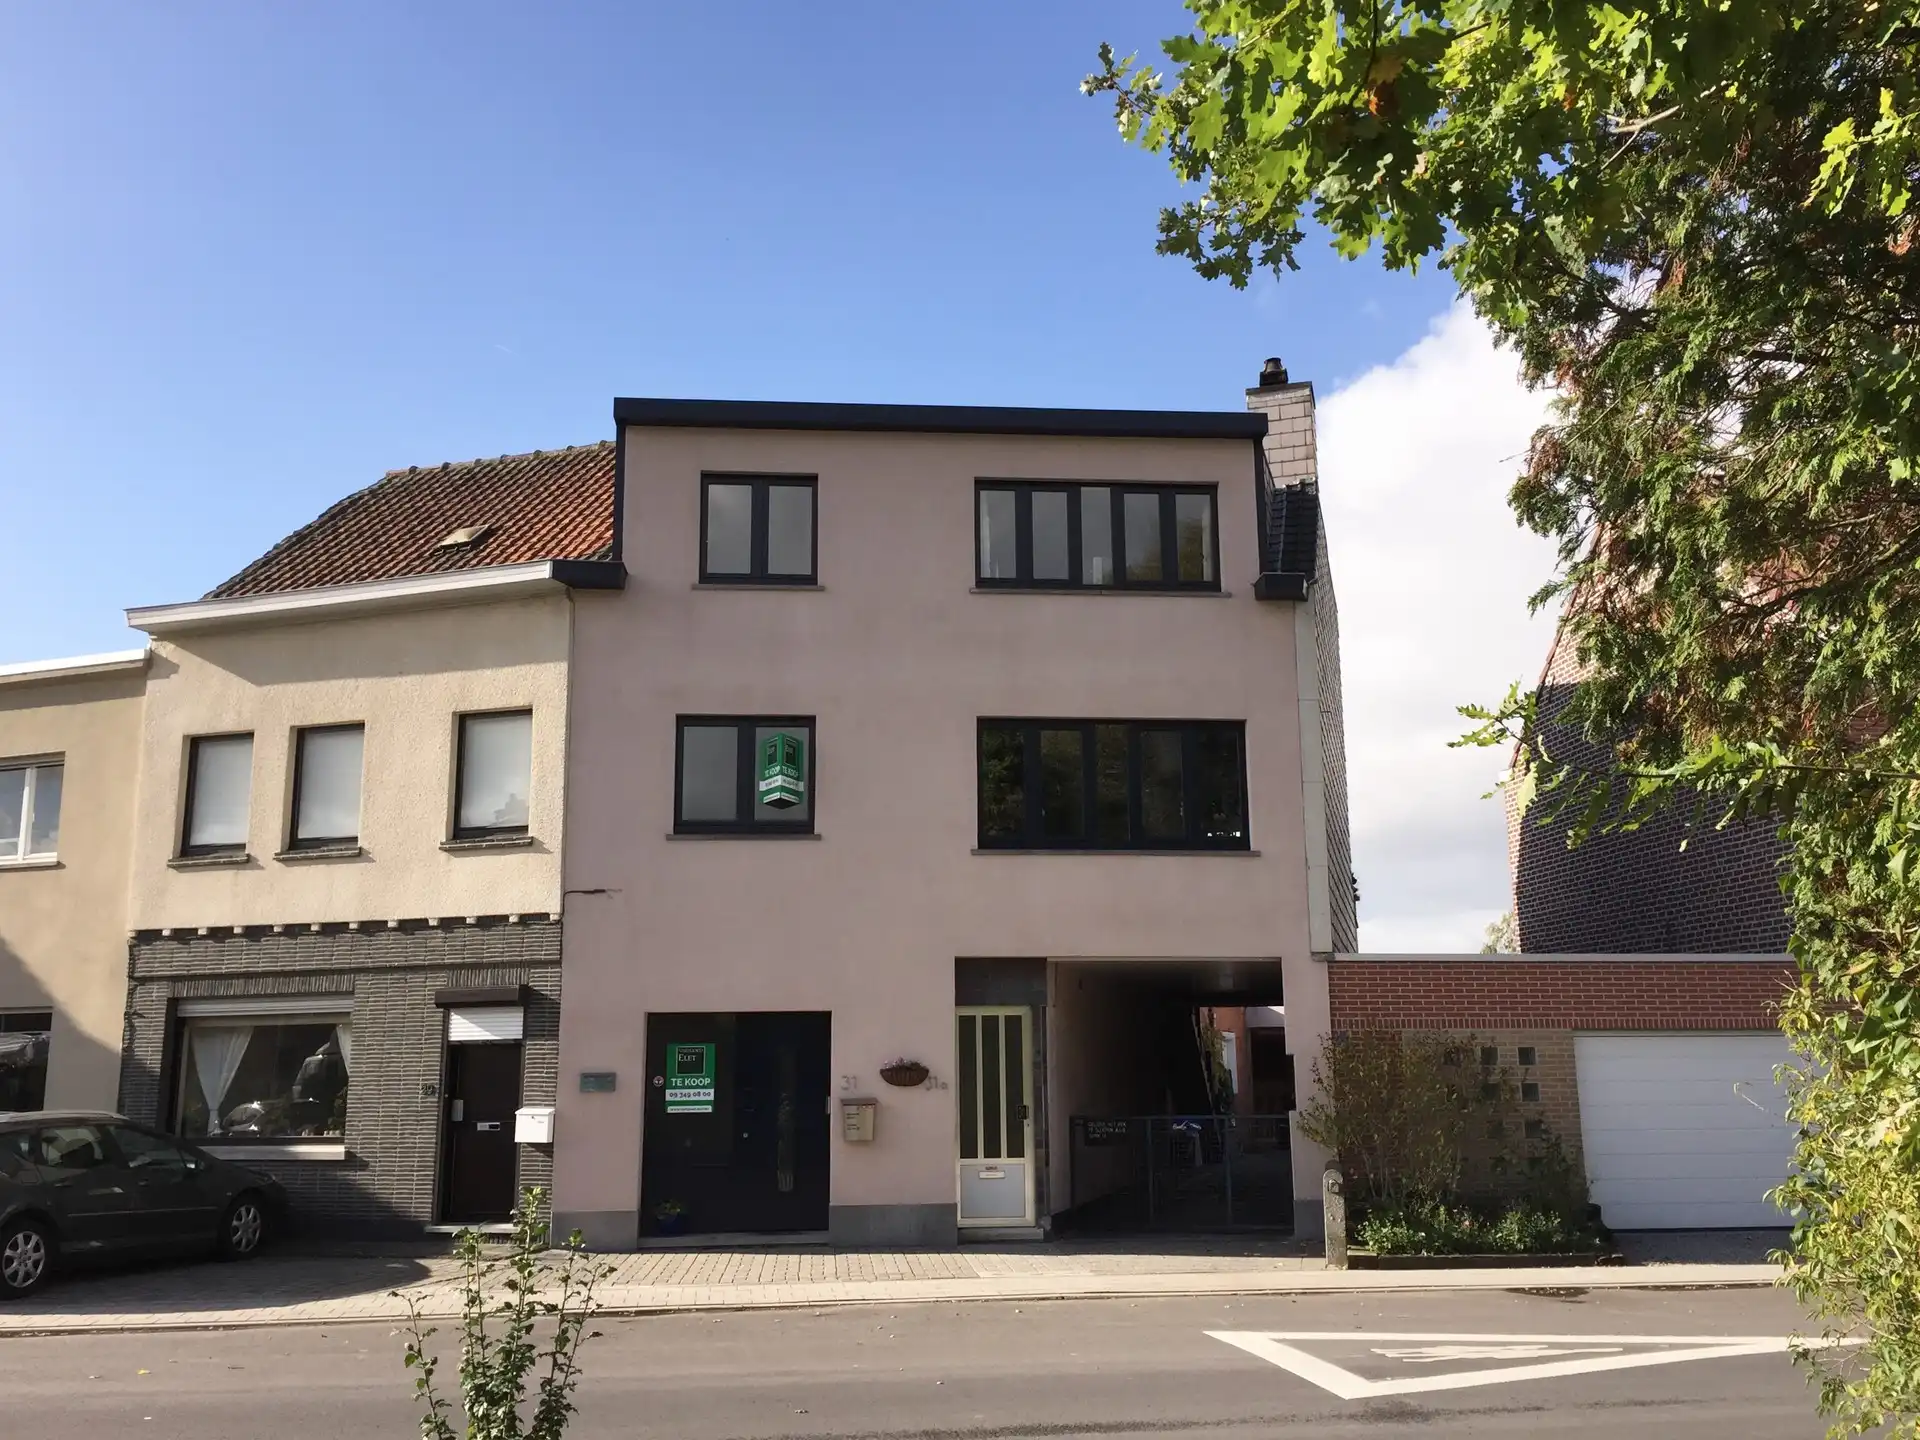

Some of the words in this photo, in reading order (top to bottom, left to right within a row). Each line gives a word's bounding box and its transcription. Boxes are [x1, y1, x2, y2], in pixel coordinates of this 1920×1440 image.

[670, 1078, 683, 1086] TE
[684, 1077, 711, 1086] KOOP
[840, 1075, 857, 1090] 31
